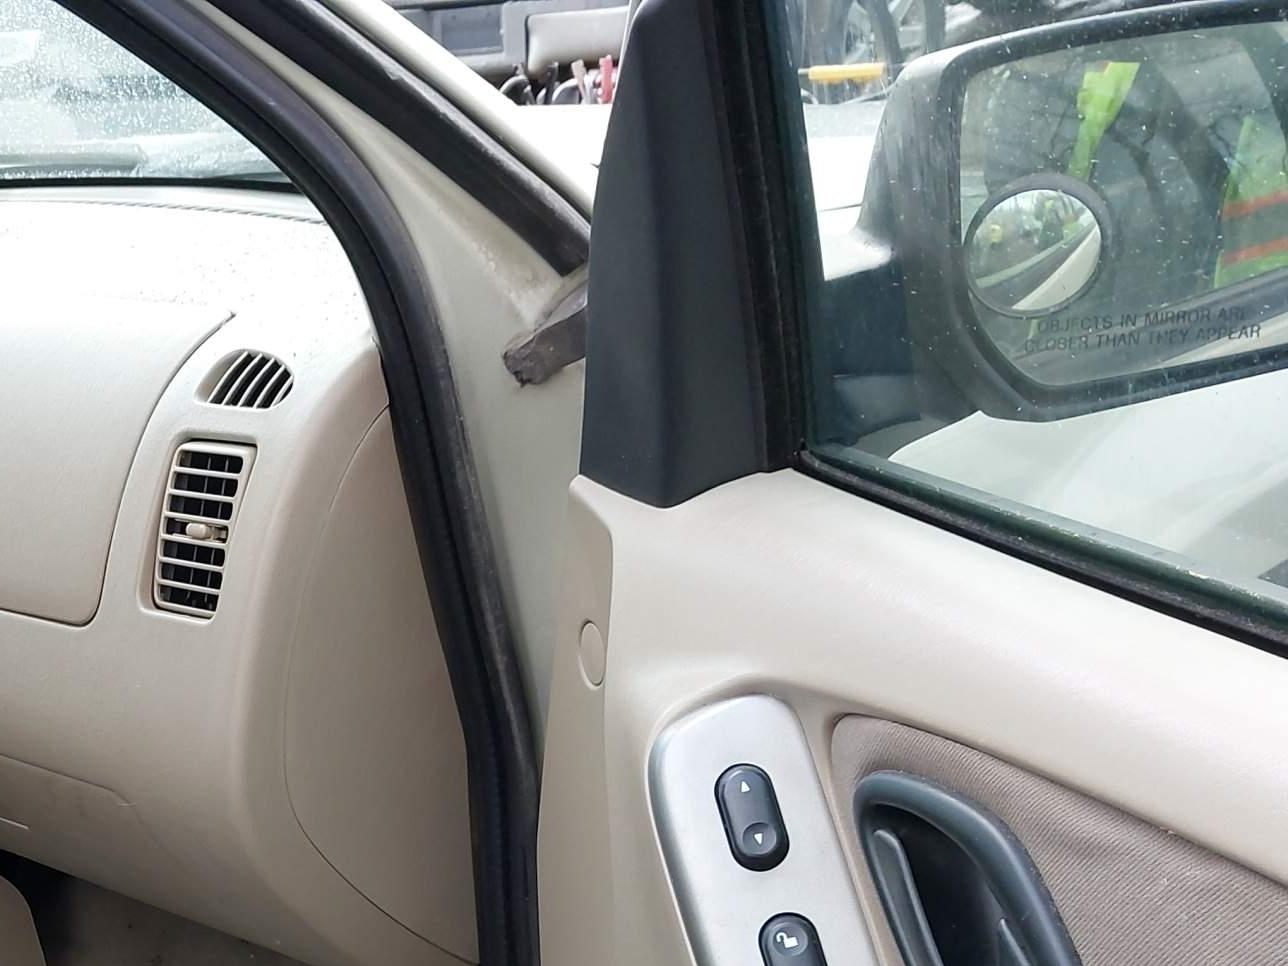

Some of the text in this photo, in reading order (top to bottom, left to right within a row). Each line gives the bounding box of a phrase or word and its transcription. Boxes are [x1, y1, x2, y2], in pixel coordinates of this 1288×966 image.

[1120, 313, 1137, 328] IN
[1144, 309, 1211, 327] MIRROR
[1024, 323, 1261, 353] CLOSER THAN THEY APPEAR
